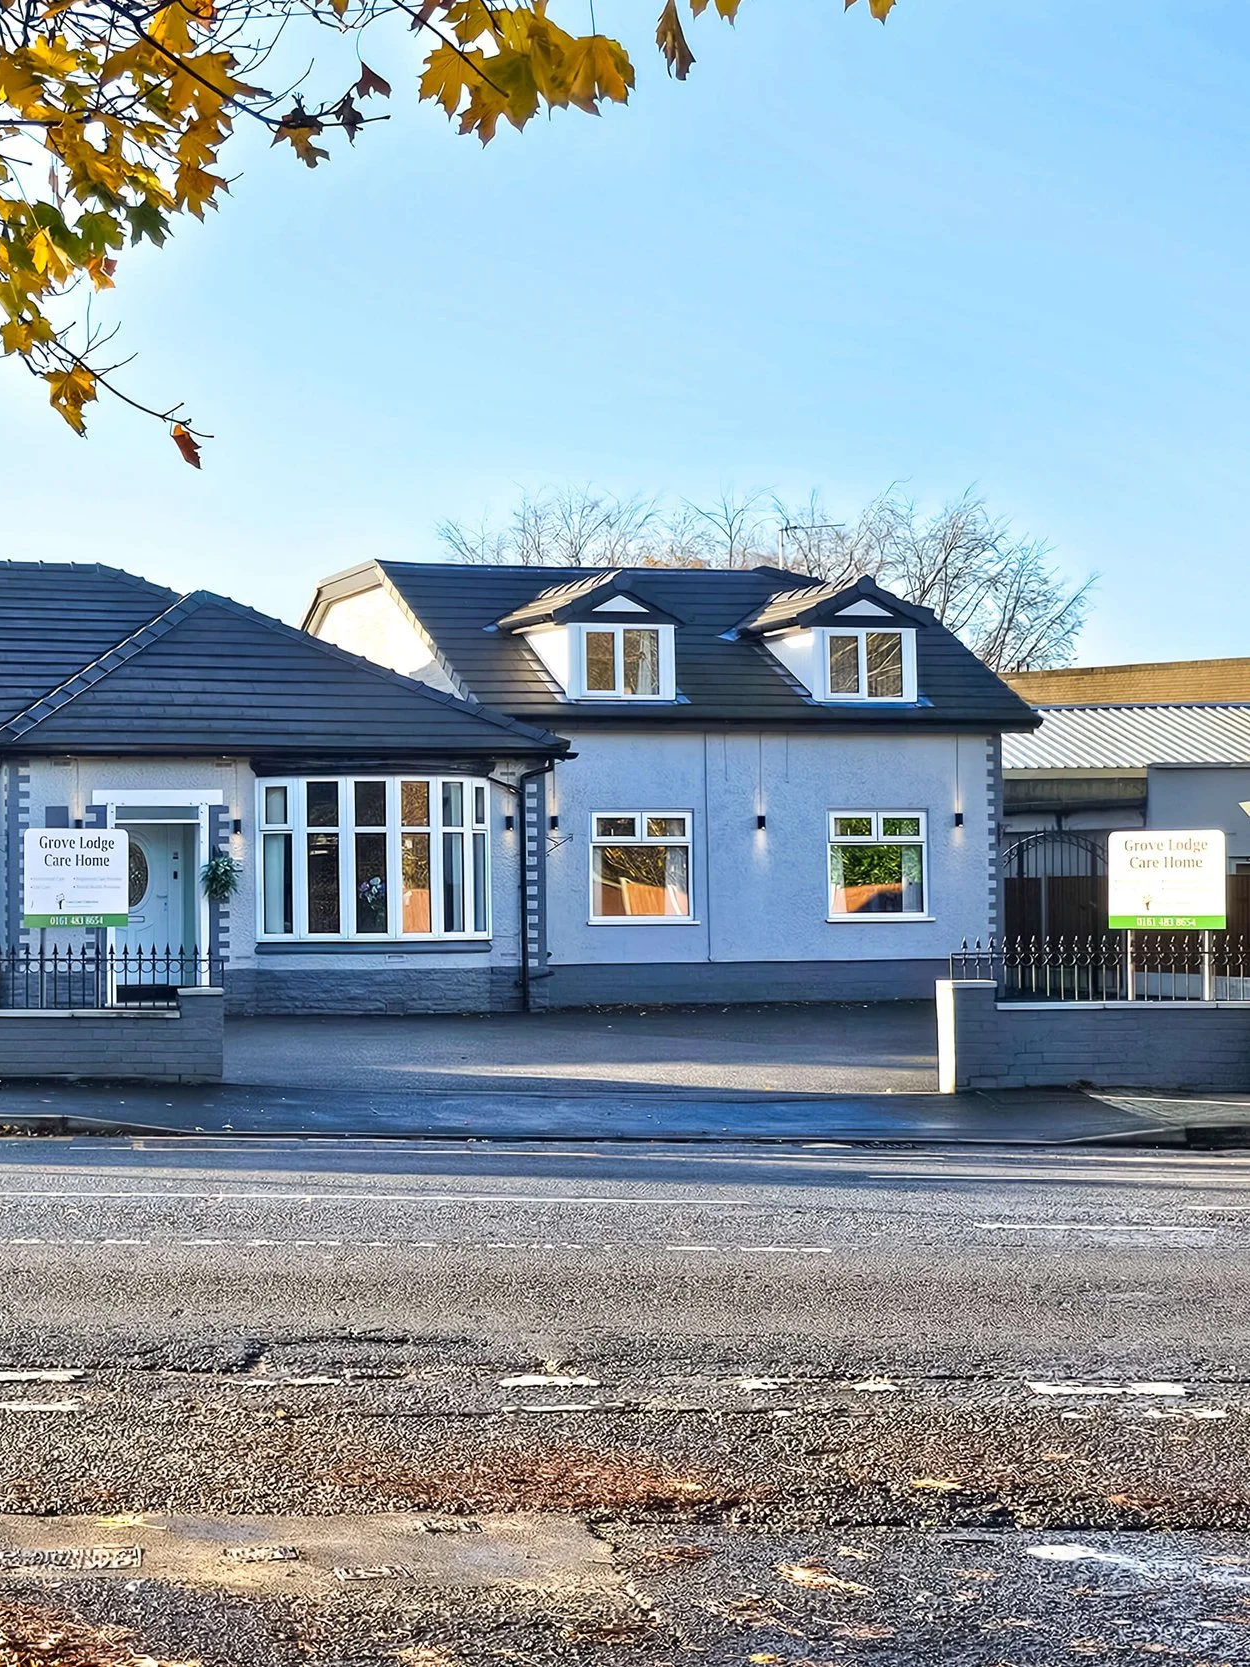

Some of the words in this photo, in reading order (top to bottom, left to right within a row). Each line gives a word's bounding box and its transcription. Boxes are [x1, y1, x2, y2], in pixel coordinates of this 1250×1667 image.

[39, 835, 75, 849] Grove
[80, 836, 115, 852] Lodge
[1124, 839, 1164, 852] Grove
[1168, 837, 1208, 853] Lodge
[44, 853, 71, 867] Care
[75, 854, 110, 866] Home
[1129, 856, 1159, 869] Care
[1164, 856, 1203, 868] Home
[49, 916, 68, 925] 0161
[70, 916, 84, 925] 483
[85, 916, 103, 925] 8654
[1136, 917, 1156, 927] 0161
[1158, 917, 1174, 927] 483
[1175, 917, 1196, 927] 8654
